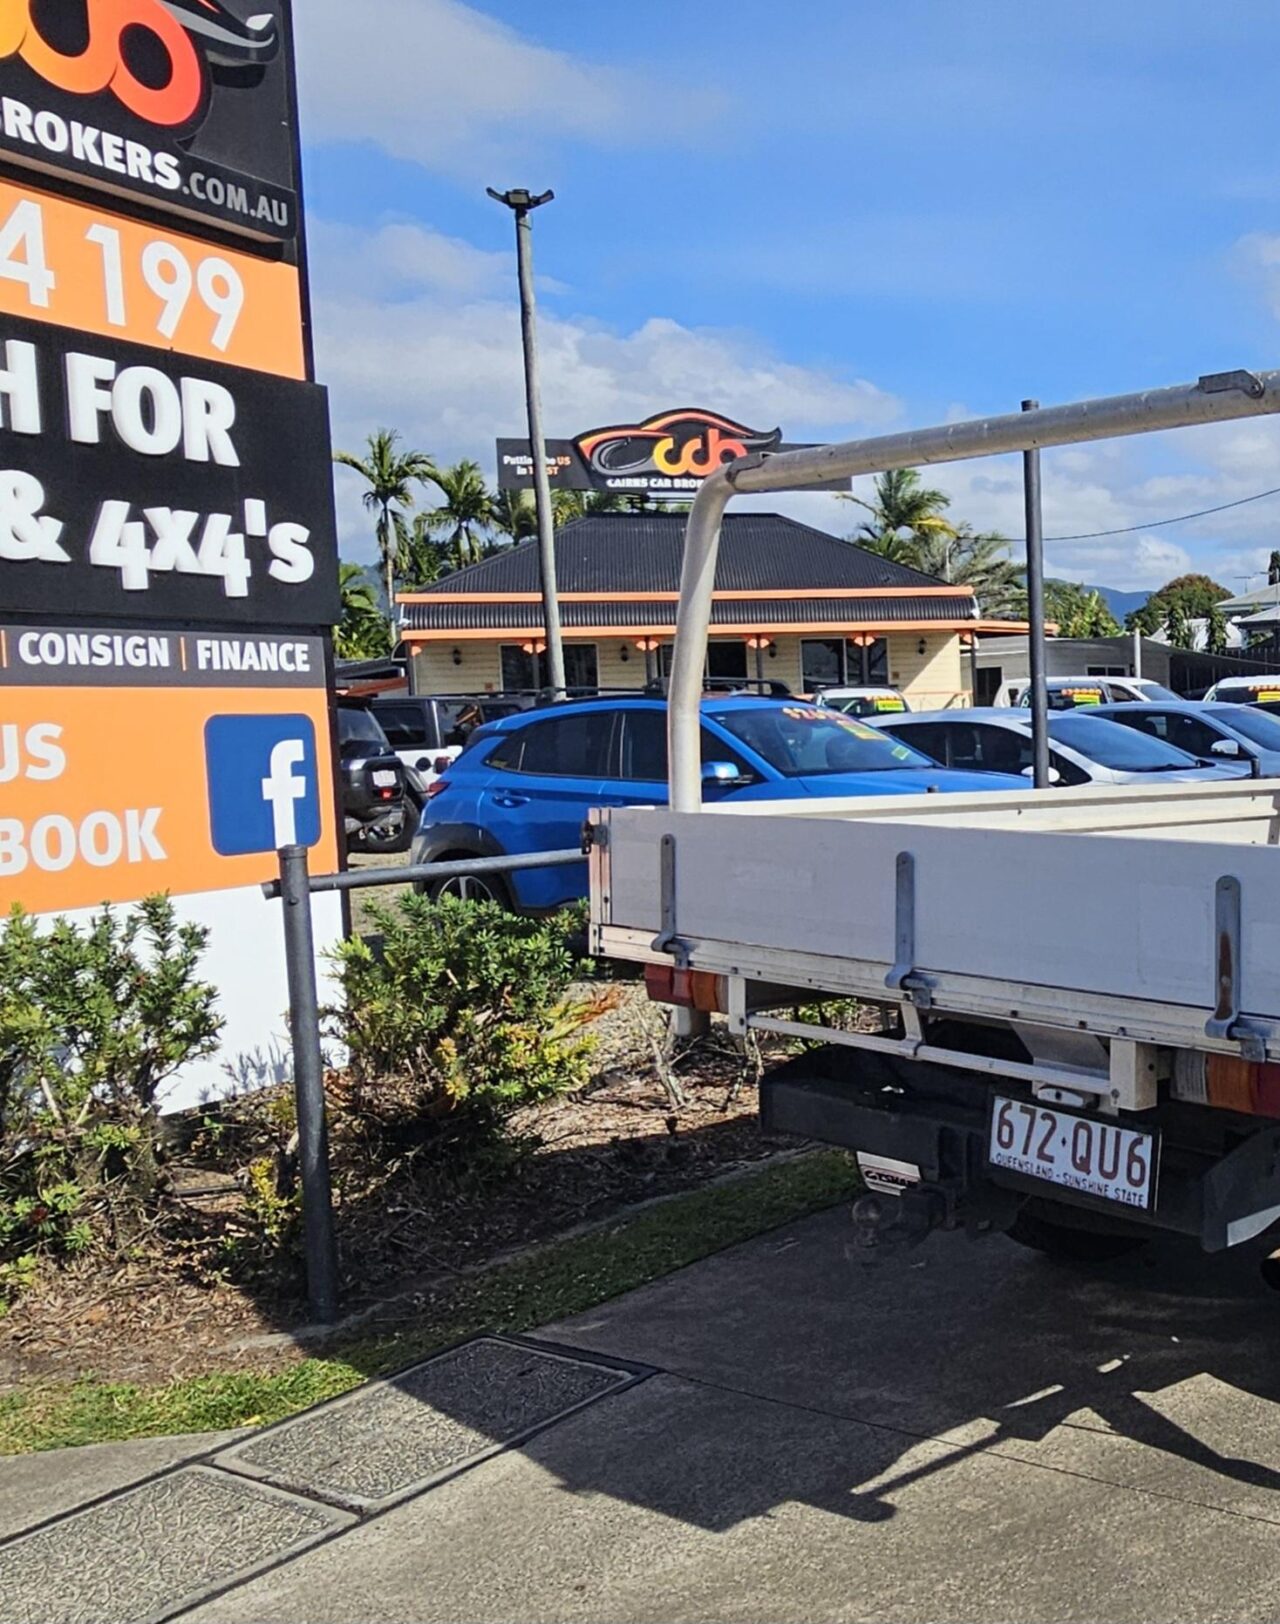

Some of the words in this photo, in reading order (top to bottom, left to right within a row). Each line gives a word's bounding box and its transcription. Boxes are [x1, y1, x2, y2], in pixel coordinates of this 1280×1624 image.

[0, 96, 288, 227] ROKERS.COM.AU
[66, 352, 241, 467] FOR
[557, 456, 571, 465] US
[606, 478, 648, 488] CAIRNS
[650, 478, 672, 488] CAR
[18, 632, 170, 667] CONSIGN
[196, 640, 310, 672] FINANCE
[995, 1153, 1053, 1180] QUEENSLAND
[1062, 1172, 1110, 1197] SUNSHINE
[1114, 1187, 1145, 1206] STATE
